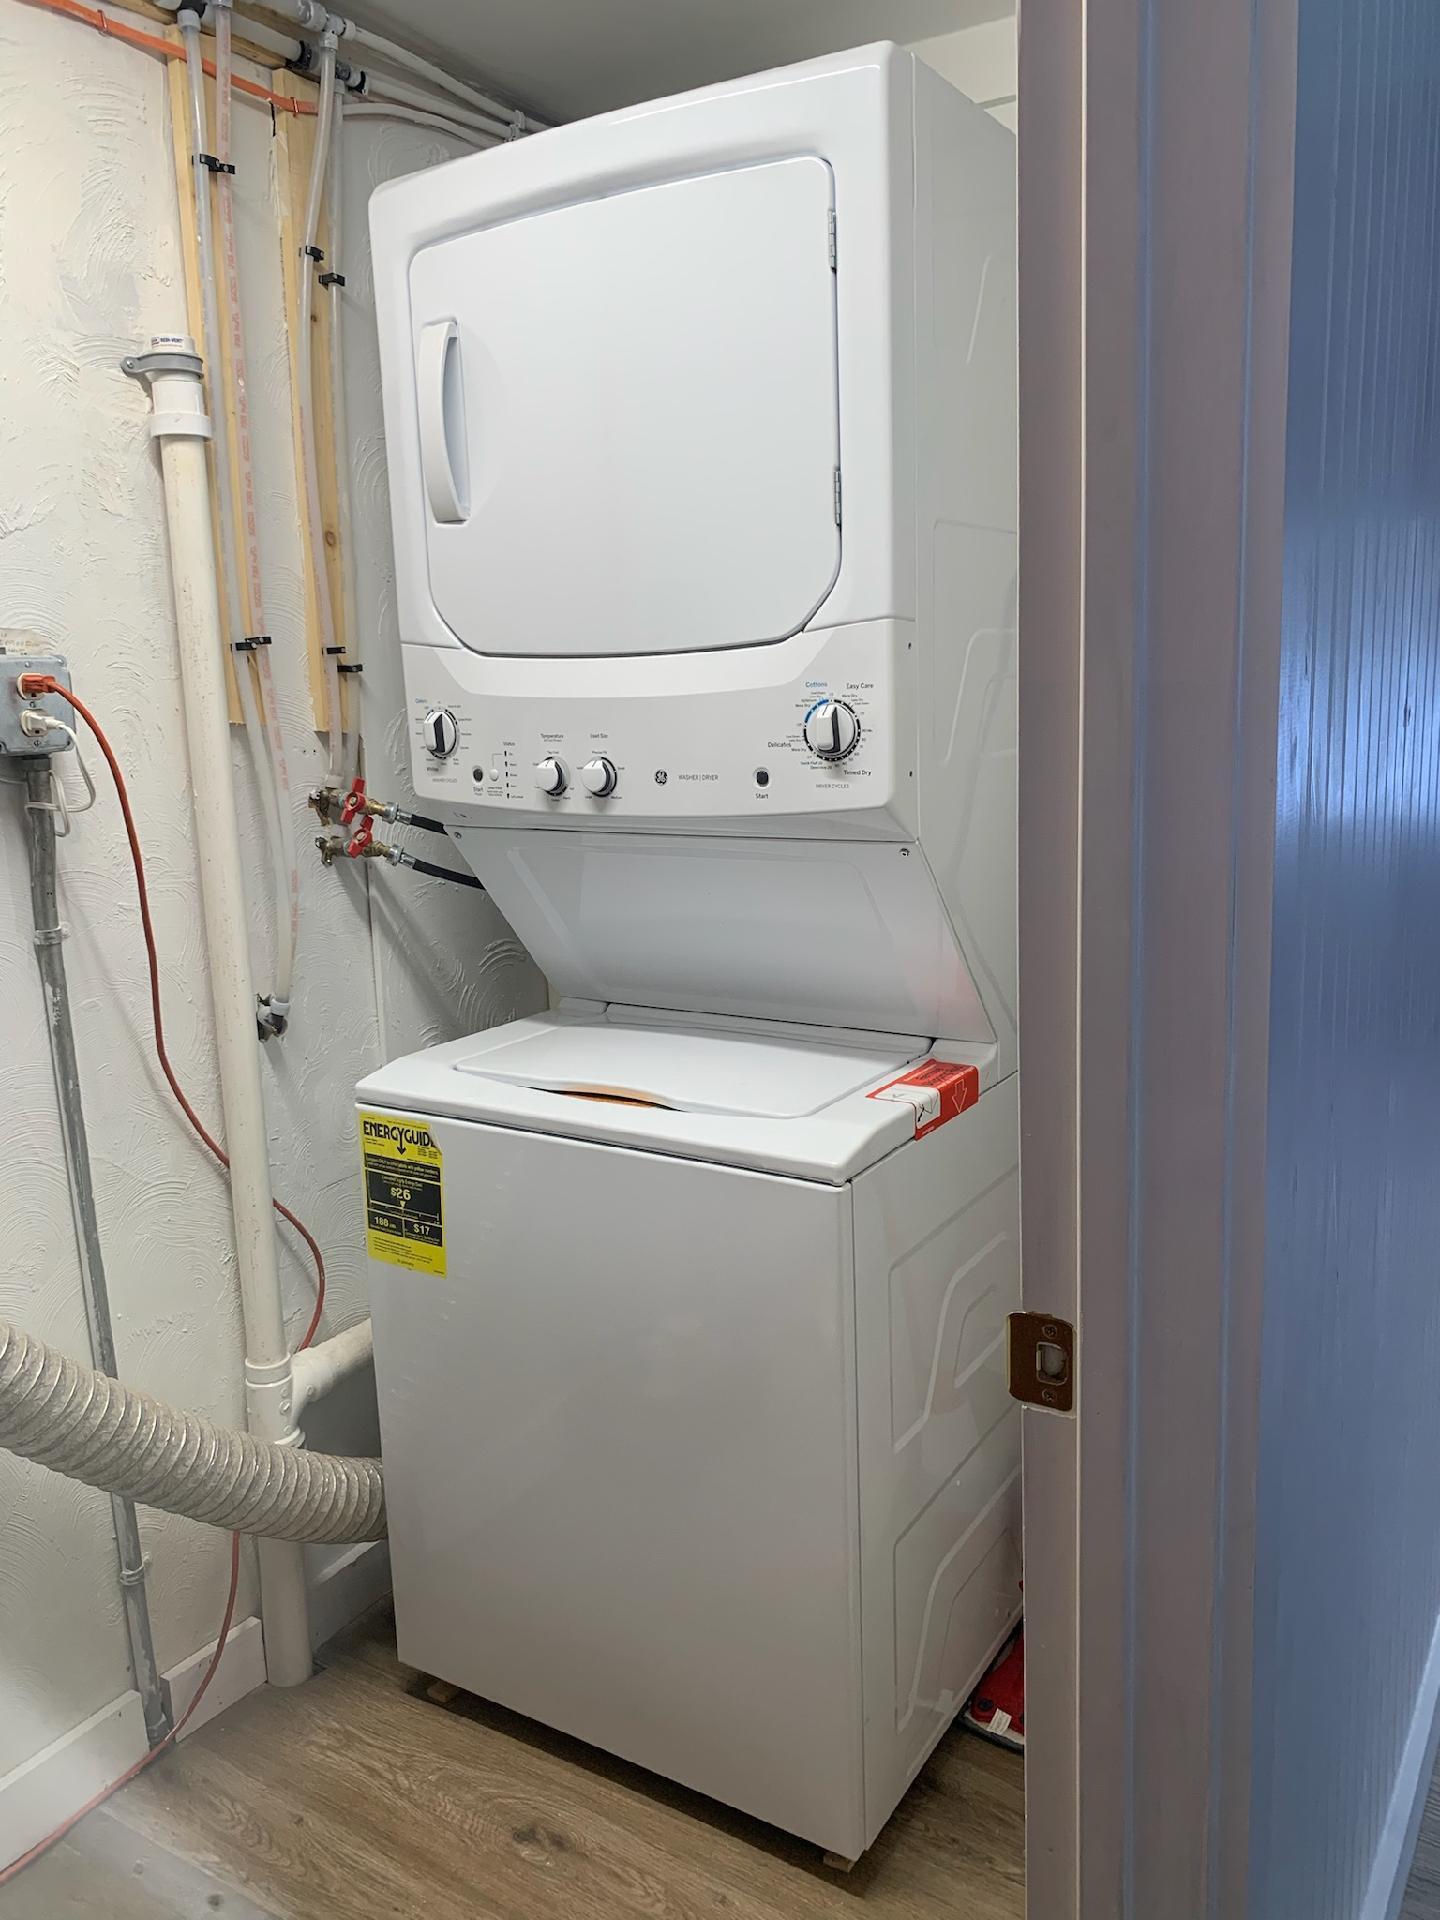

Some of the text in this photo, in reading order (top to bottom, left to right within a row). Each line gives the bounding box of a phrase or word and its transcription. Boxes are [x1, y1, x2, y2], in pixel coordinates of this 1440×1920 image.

[846, 682, 859, 690] Easy
[390, 1187, 412, 1201] $26
[413, 1223, 430, 1236] $17
